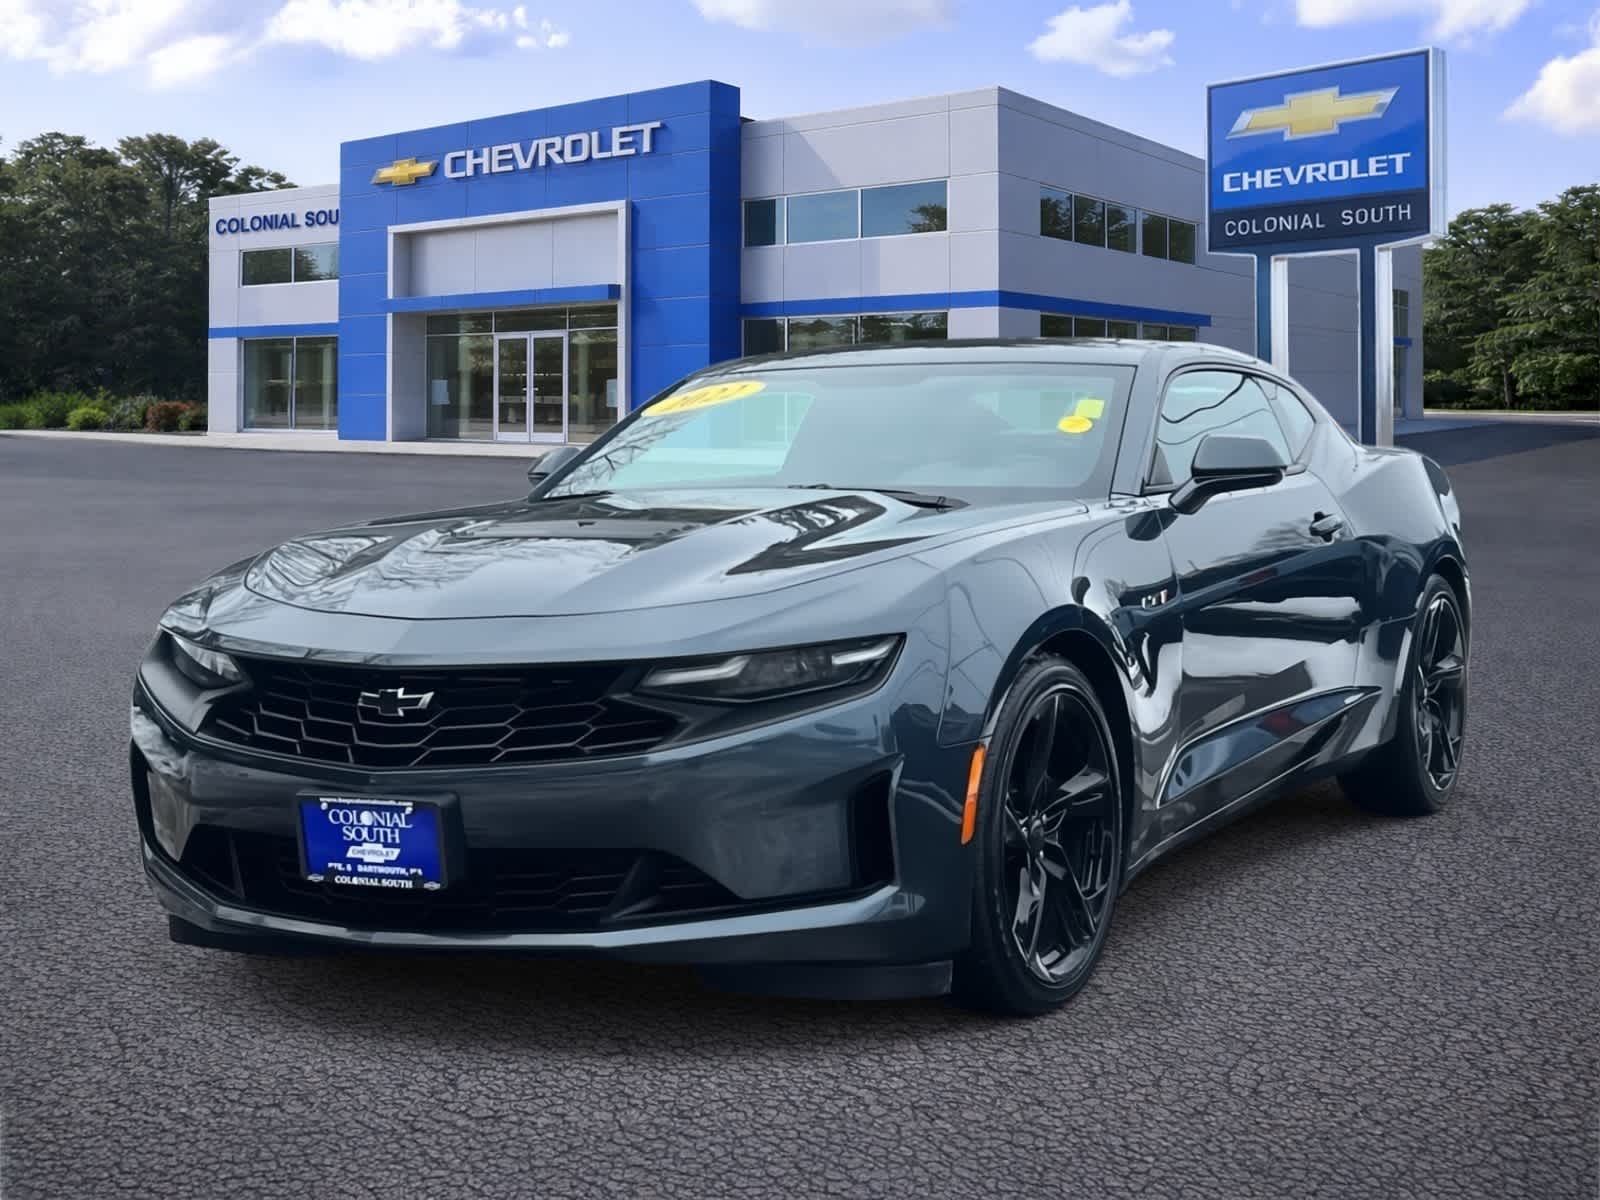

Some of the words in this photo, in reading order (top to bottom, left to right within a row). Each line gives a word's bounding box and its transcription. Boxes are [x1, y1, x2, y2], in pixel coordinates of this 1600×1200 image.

[443, 121, 663, 179] CHEVROLET
[1223, 152, 1412, 193] CHEVROLET
[215, 213, 300, 235] COLONIAL
[305, 208, 340, 228] SOU
[1224, 212, 1326, 237] COLONIAL
[1341, 203, 1412, 226] SOUTH
[328, 809, 413, 828] COLONIAL
[342, 826, 400, 843] SOUTH
[351, 848, 395, 857] CHEVROLET
[335, 875, 380, 886] COLONIAL
[381, 879, 413, 888] SOUTH
